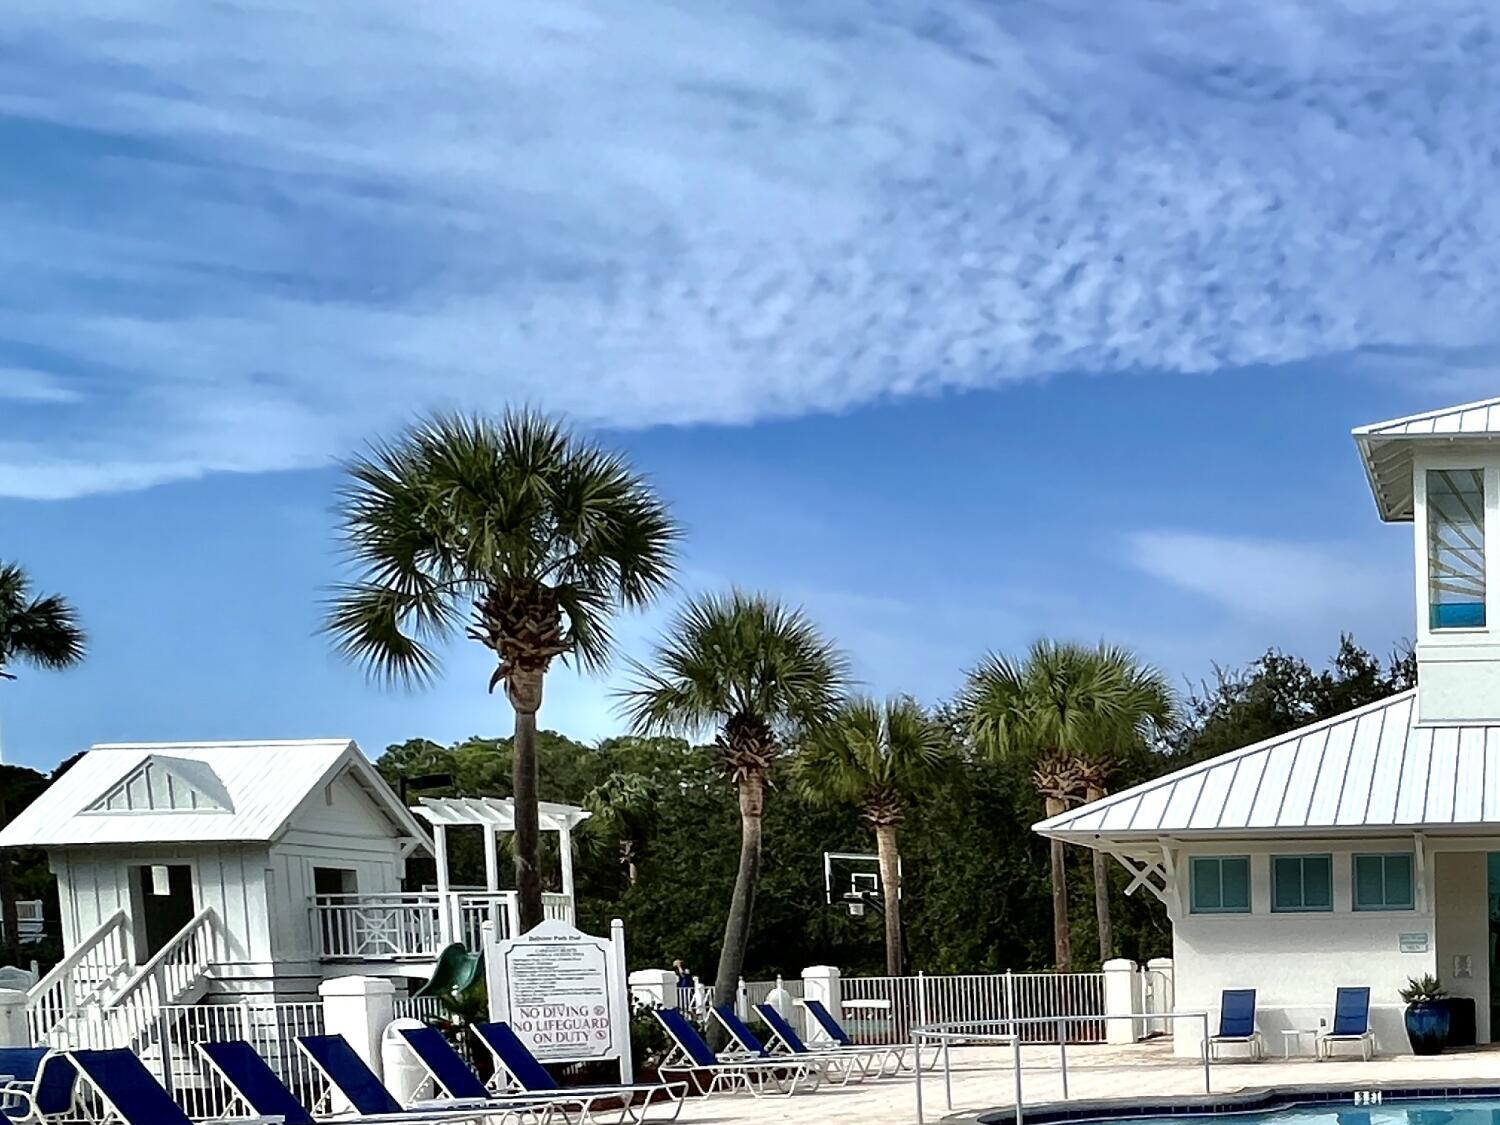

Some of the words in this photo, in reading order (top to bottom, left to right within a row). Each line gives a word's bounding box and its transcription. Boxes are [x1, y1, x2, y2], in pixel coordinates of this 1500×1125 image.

[520, 1007, 540, 1019] NO
[543, 1005, 589, 1018] DIVING
[513, 1020, 533, 1032] NO
[536, 1017, 609, 1031] LIFEGUARD
[533, 1033, 552, 1044] ON
[556, 1031, 589, 1043] DUTY
